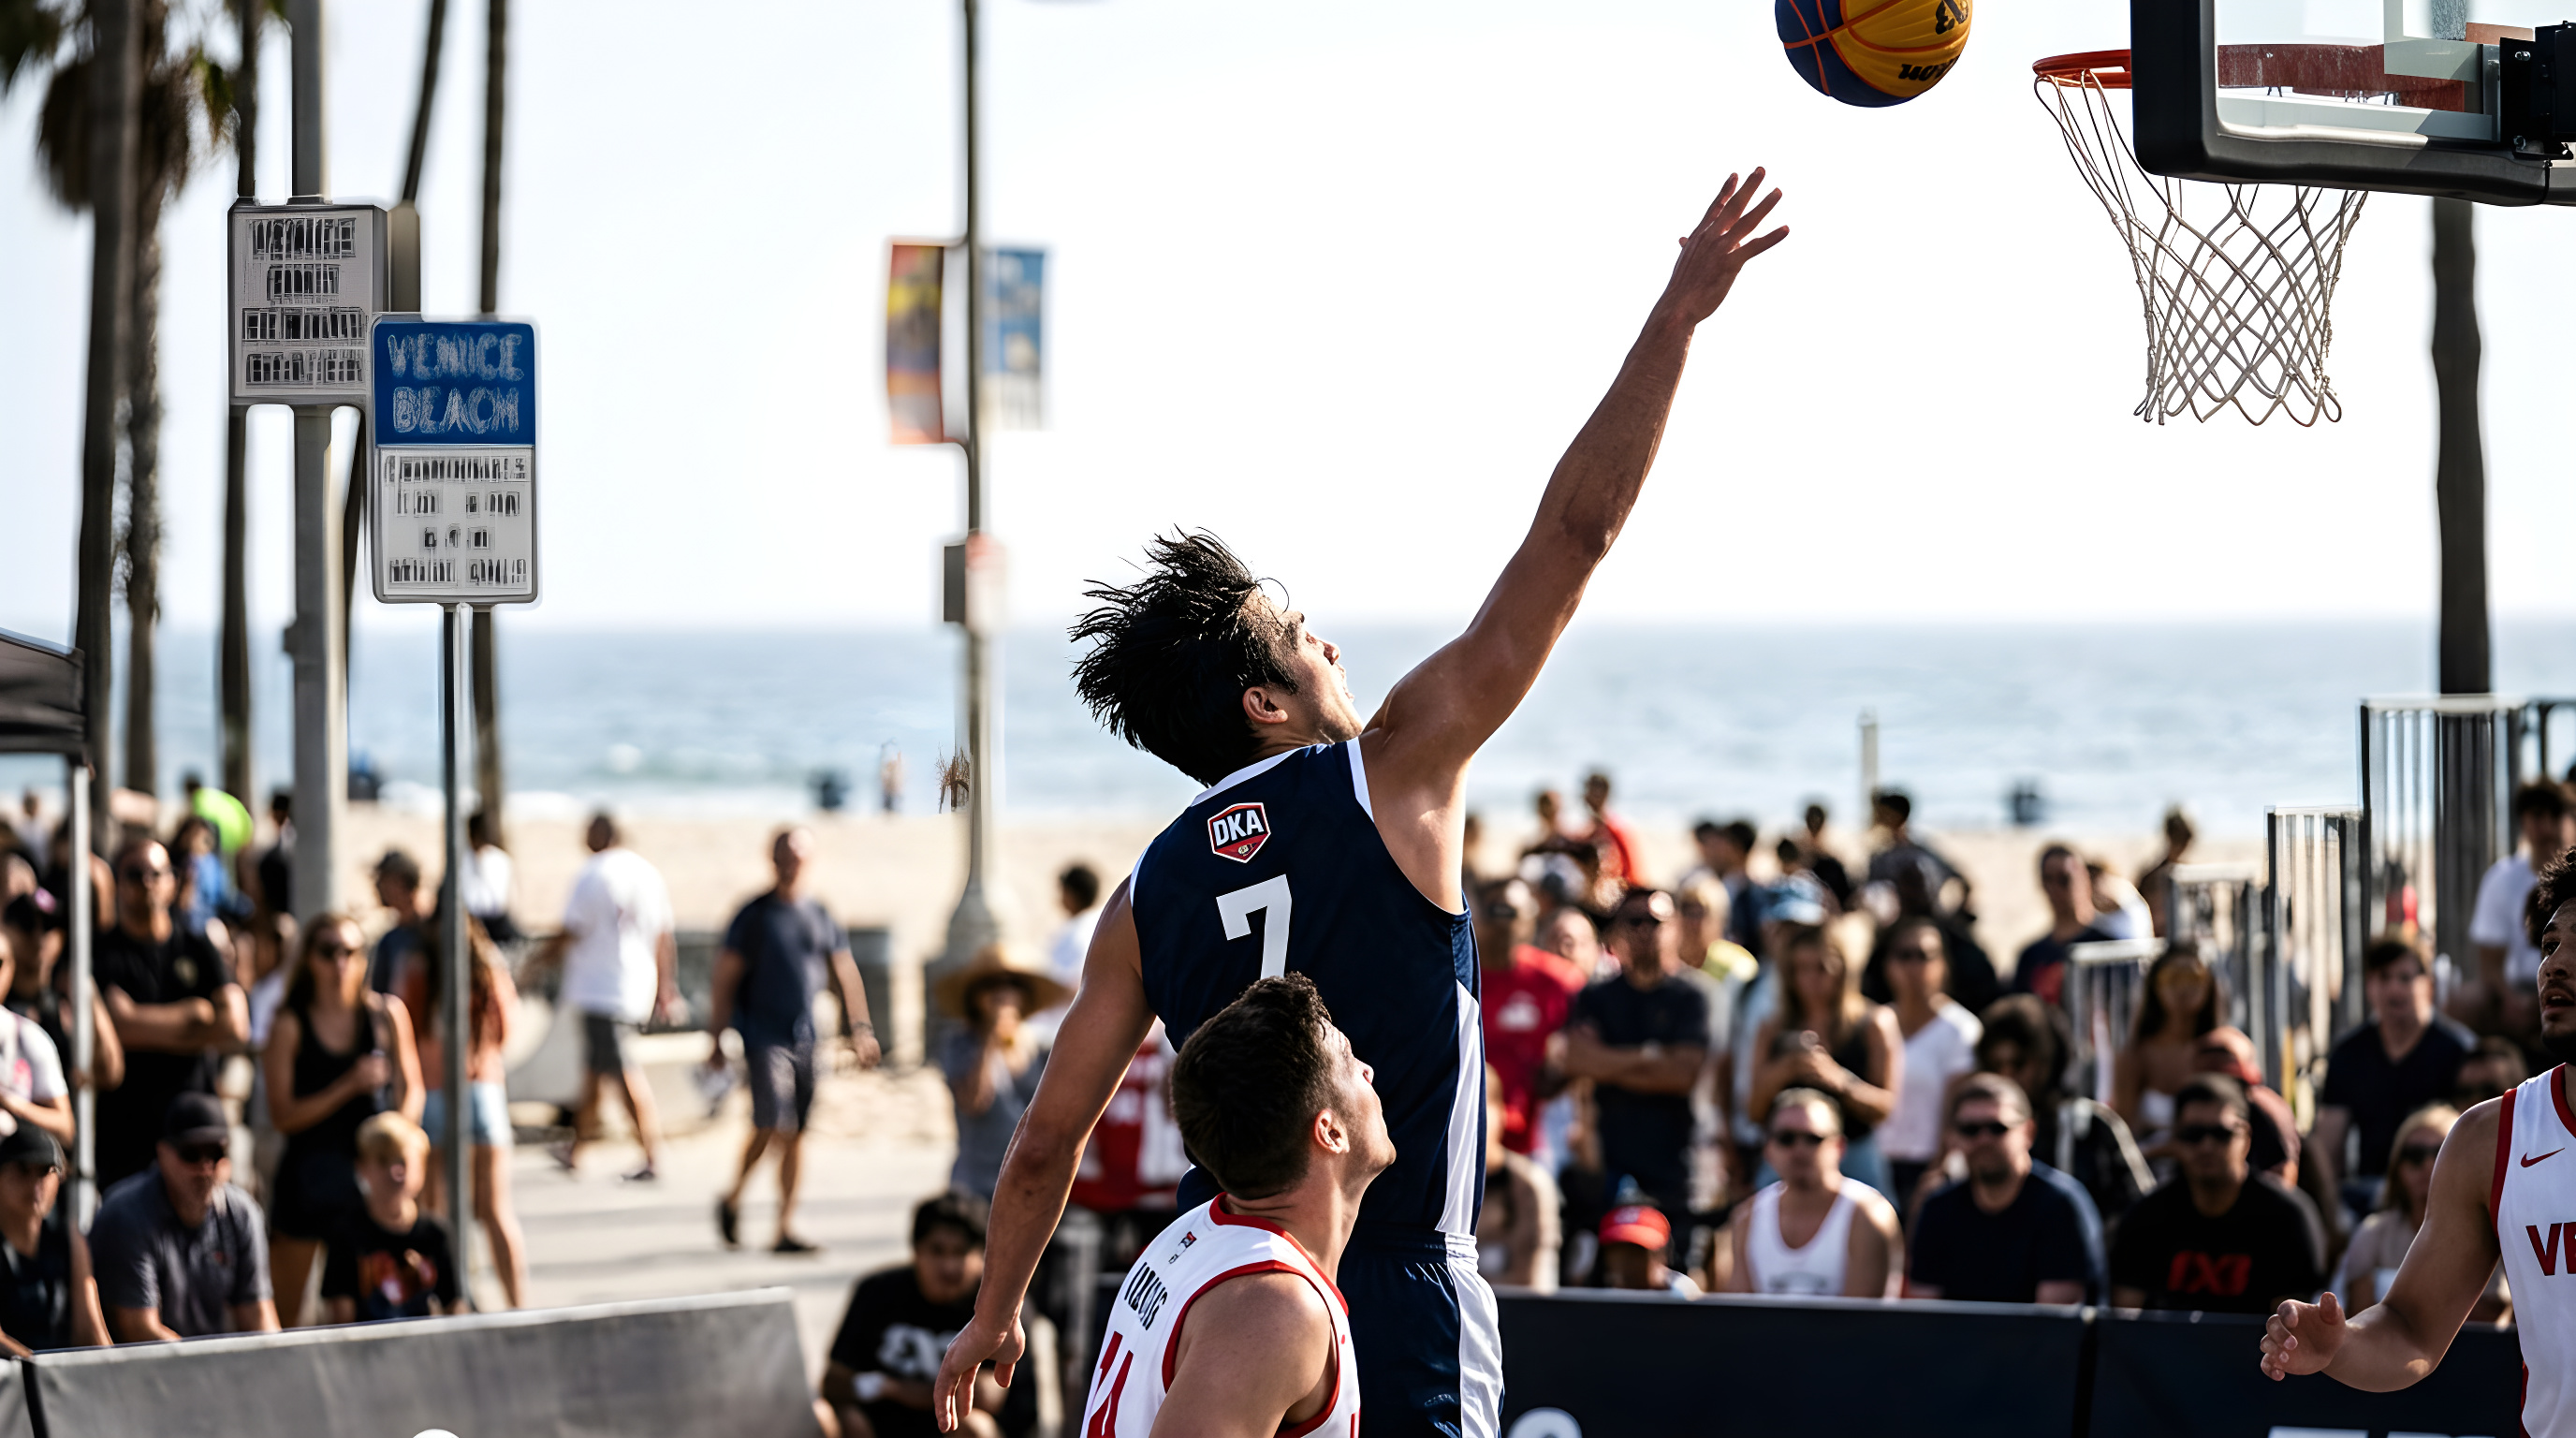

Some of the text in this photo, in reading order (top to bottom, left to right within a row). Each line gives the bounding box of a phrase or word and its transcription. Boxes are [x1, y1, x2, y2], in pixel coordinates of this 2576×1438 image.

[388, 332, 524, 382] VENICE
[1213, 810, 1264, 846] DKA
[1216, 873, 1292, 980] 7
